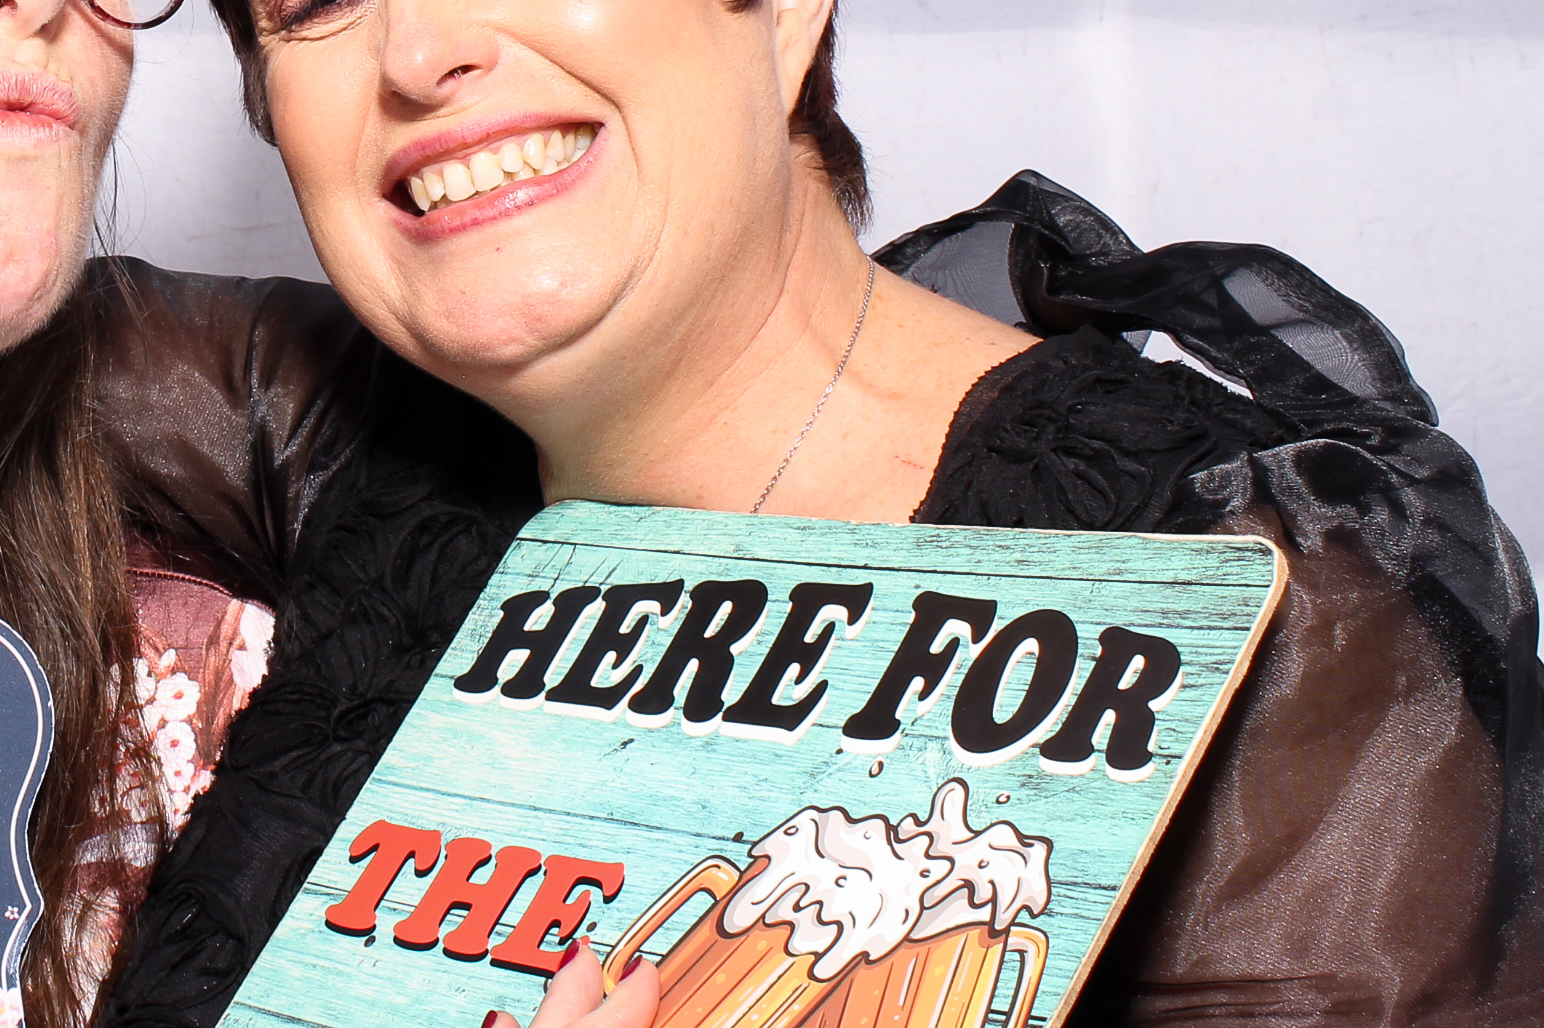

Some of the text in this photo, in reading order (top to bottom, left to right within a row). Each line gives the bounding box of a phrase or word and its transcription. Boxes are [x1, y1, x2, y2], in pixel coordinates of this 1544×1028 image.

[453, 578, 1184, 783] HERE FOR
[324, 818, 626, 974] THE
